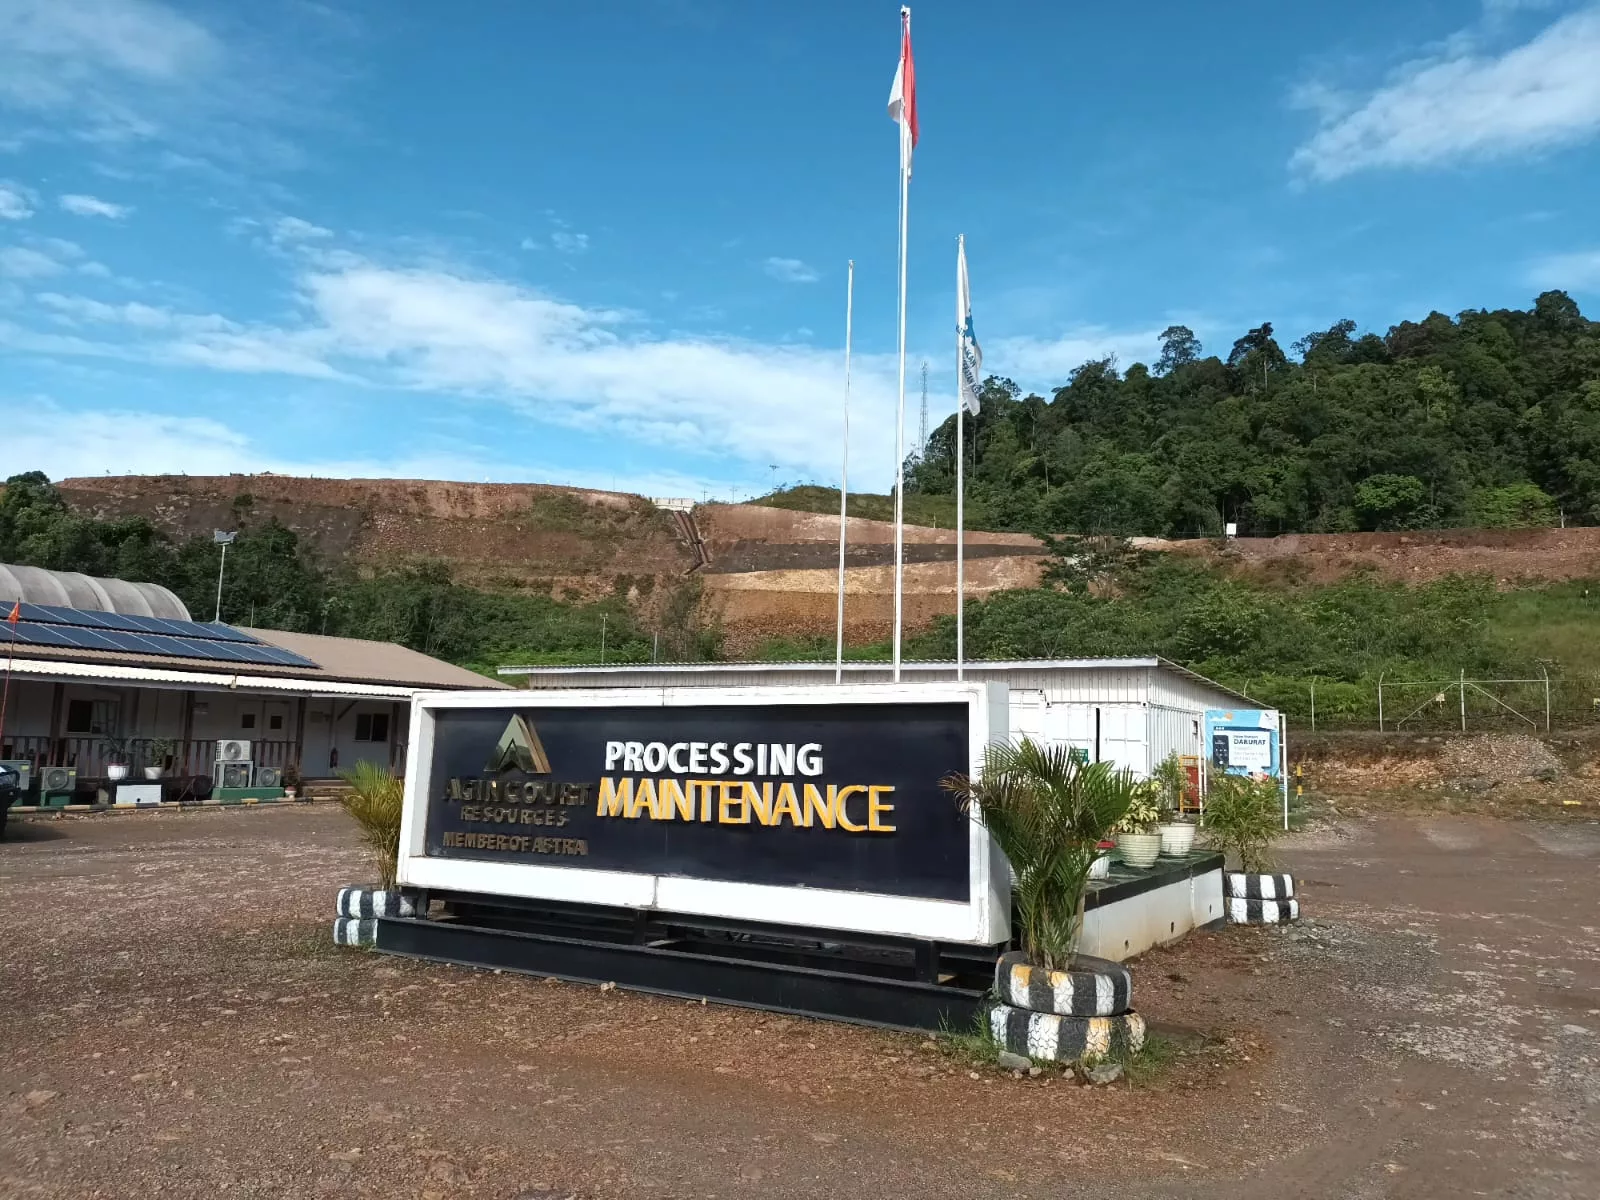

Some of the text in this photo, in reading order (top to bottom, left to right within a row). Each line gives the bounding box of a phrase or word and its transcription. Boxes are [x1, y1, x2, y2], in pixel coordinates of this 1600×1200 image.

[605, 741, 824, 776] PROCESSING
[443, 777, 594, 806] AGINCOURT
[596, 776, 897, 832] MAINTENANCE
[460, 806, 570, 827] RESOURCES
[442, 832, 589, 856] MEMBER OF ASTRA
